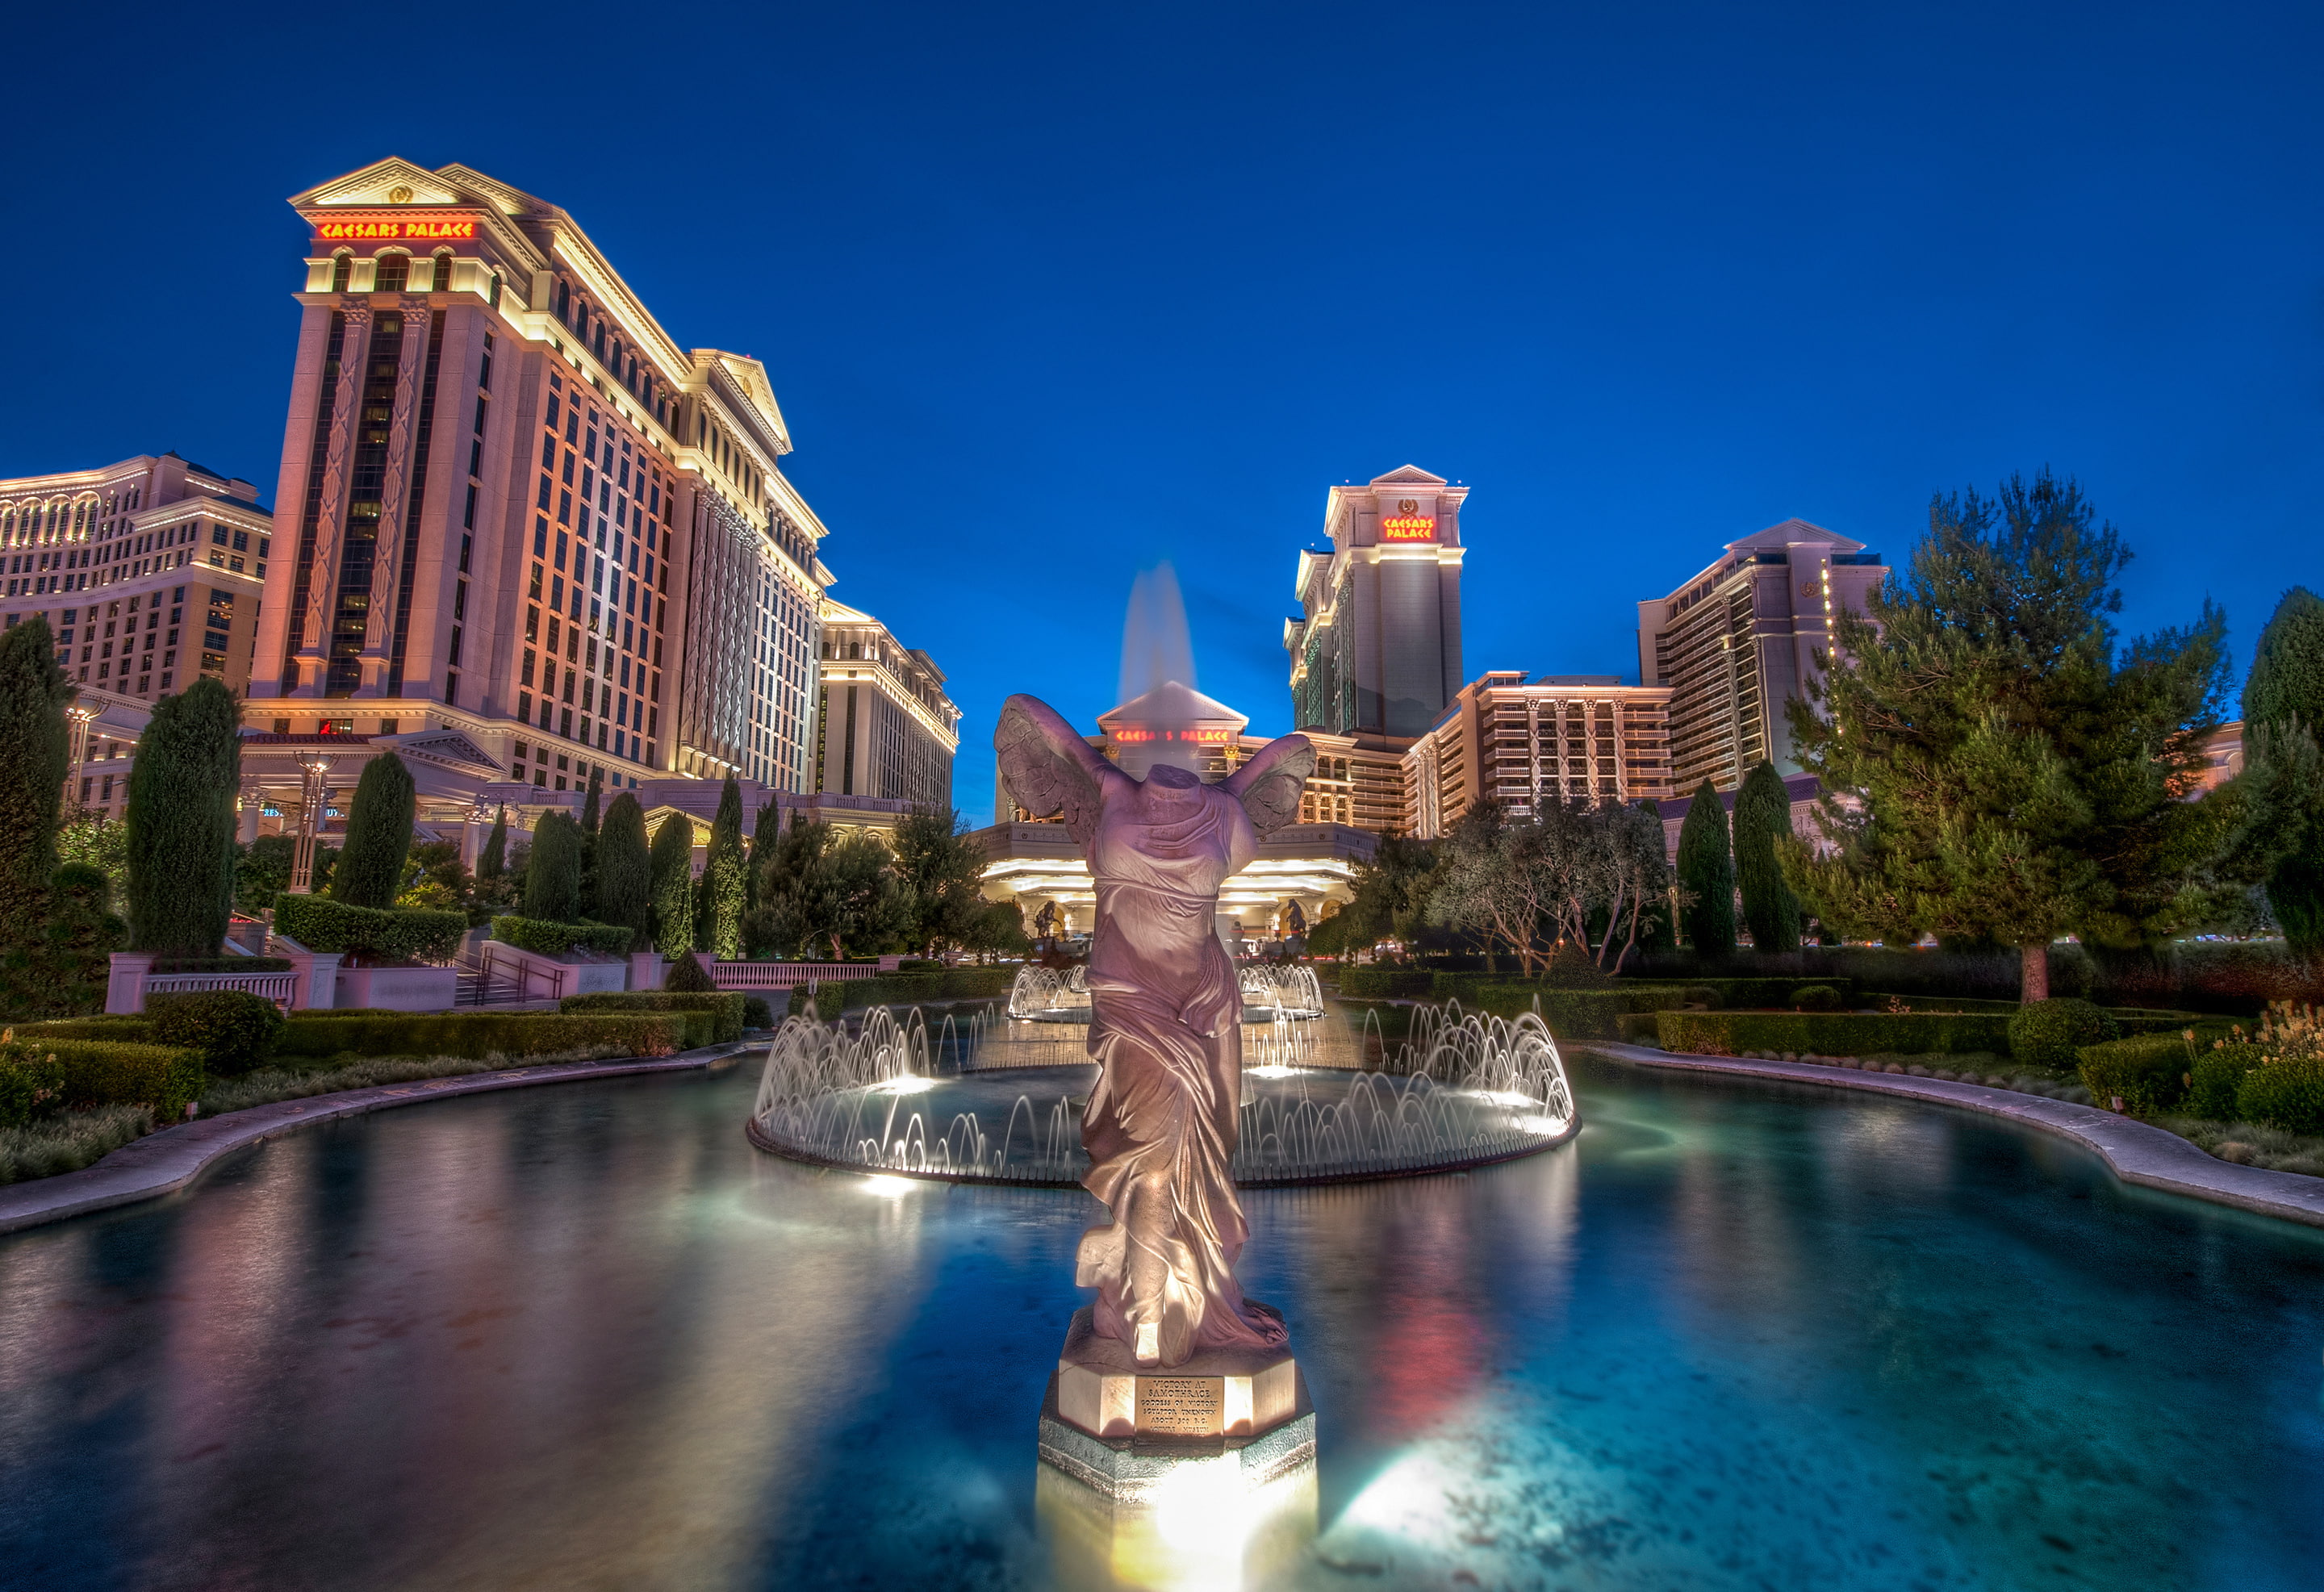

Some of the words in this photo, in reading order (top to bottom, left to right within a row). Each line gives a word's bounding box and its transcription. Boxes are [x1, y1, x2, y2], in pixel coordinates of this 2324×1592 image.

[320, 224, 399, 238] CAESARS
[406, 223, 472, 237] PALACE
[1383, 519, 1434, 529] CAESARS
[1386, 529, 1432, 538] PALACE
[1181, 730, 1229, 742] PALACE
[1195, 1381, 1206, 1389] AT
[1148, 1389, 1210, 1398] SAMOTHRACE
